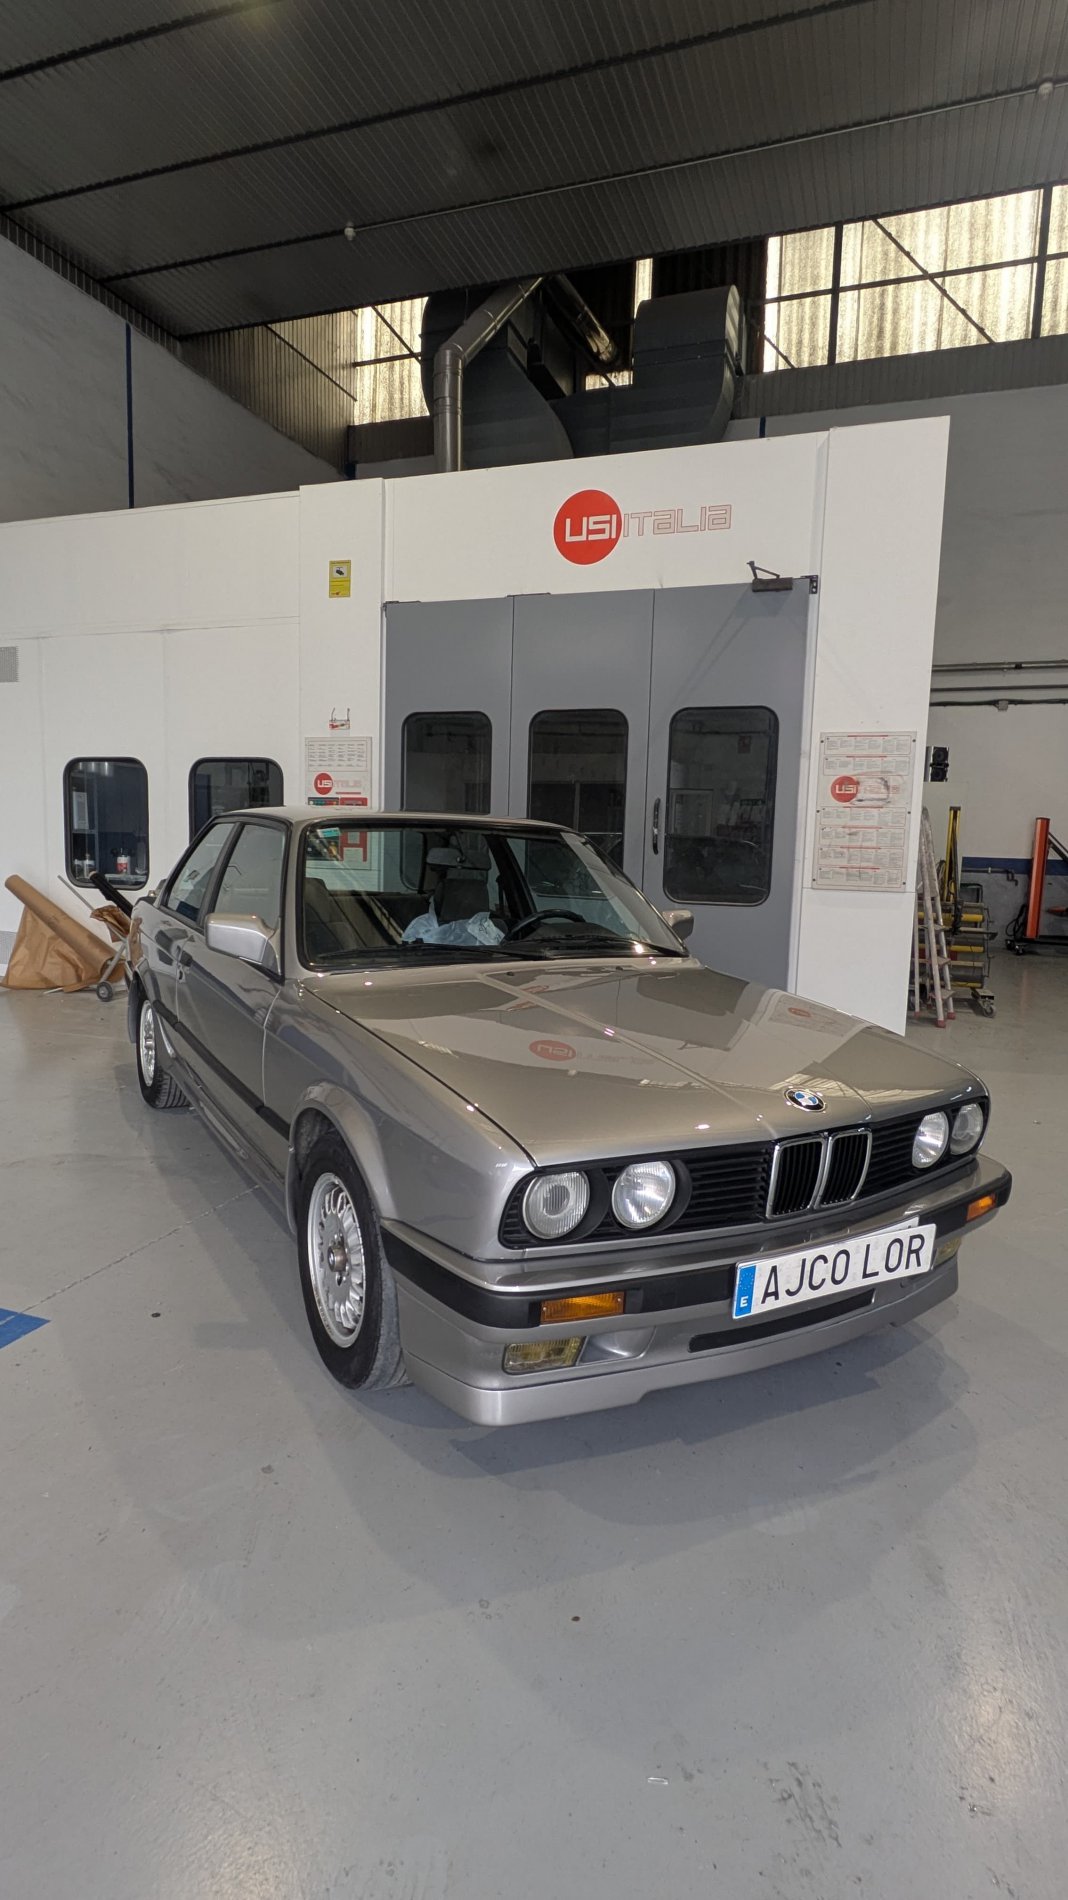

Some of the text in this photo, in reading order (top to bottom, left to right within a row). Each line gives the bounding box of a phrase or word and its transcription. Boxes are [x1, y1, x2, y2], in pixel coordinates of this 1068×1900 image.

[565, 514, 617, 542] USI
[835, 784, 857, 794] USI
[739, 1295, 749, 1308] E
